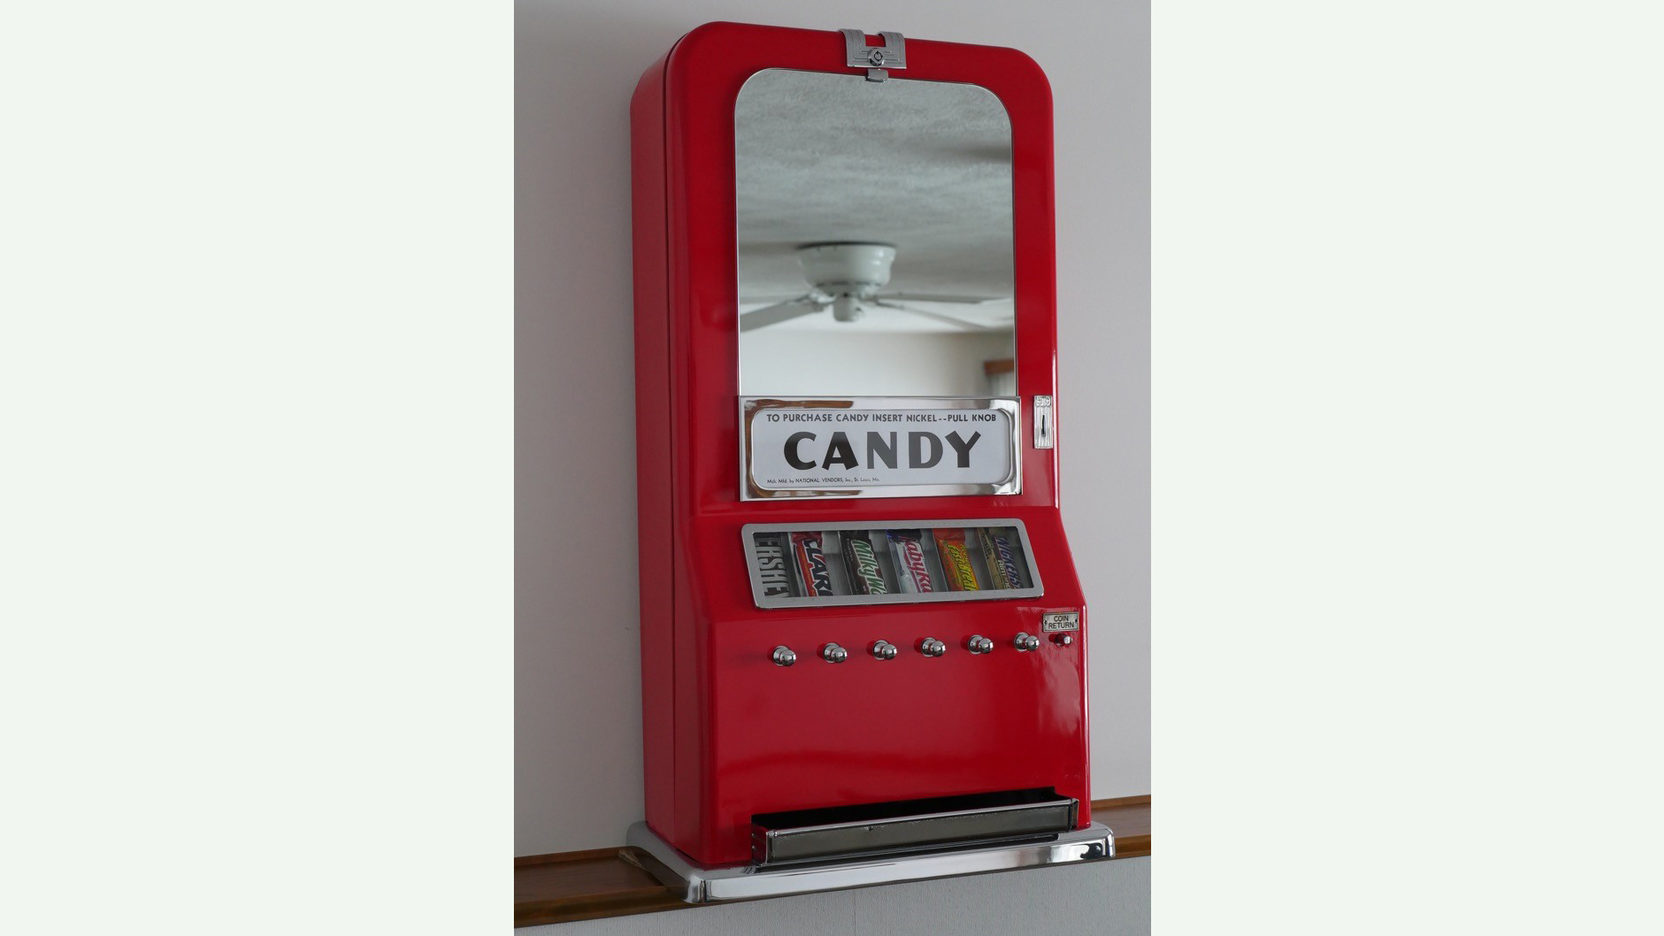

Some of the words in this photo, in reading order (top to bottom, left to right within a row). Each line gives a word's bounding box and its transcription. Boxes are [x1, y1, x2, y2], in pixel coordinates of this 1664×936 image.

[766, 413, 781, 423] TO
[783, 413, 833, 423] PURCHASE
[835, 413, 870, 423] CANDY
[871, 413, 903, 423] INSERT
[971, 413, 997, 423] KNOB
[783, 430, 982, 471] CANDY
[851, 539, 879, 577] Milky
[865, 574, 888, 595] Wa
[1048, 621, 1075, 629] RETURN
